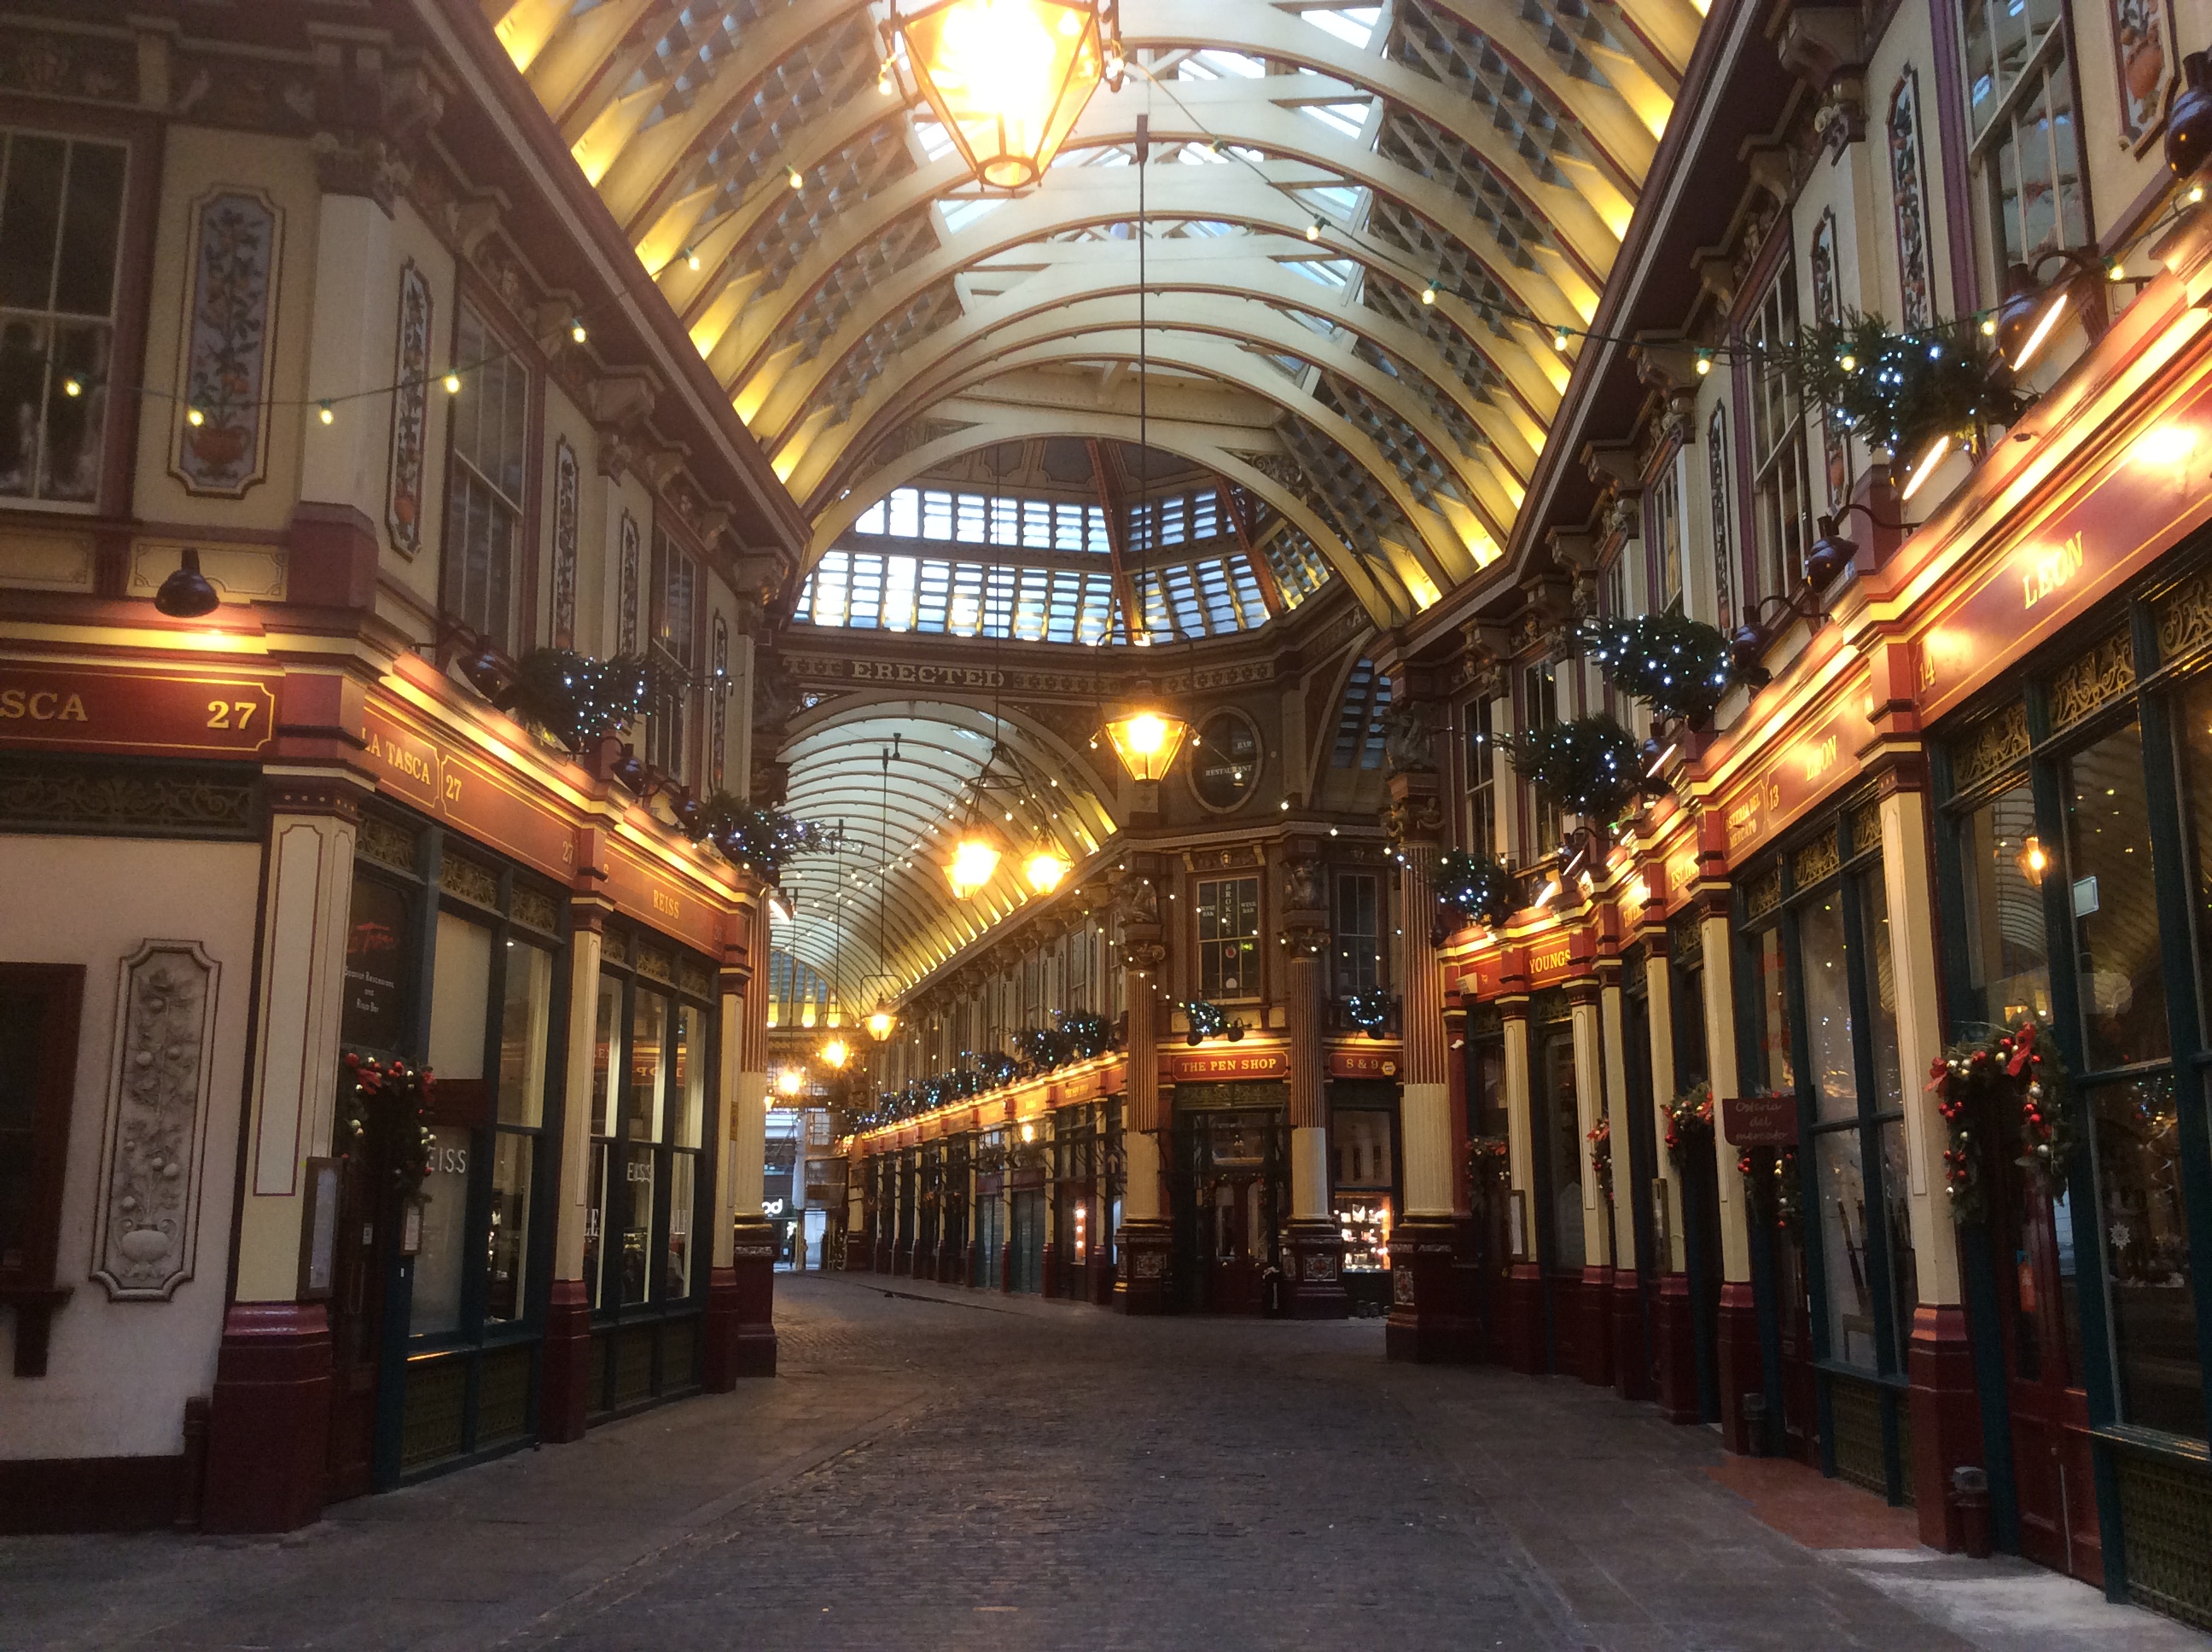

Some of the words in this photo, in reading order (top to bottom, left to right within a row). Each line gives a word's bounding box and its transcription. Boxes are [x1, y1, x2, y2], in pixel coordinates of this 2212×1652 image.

[2023, 531, 2083, 609] LEON
[852, 660, 1004, 687] ERECTED
[1919, 655, 1936, 692] 14
[0, 689, 88, 722] SCA
[207, 701, 257, 730] 27
[385, 741, 431, 785] TASCA
[1205, 765, 1253, 776] RESTAURANT
[1807, 734, 1837, 781] LEON
[445, 774, 463, 802] 27
[1769, 784, 1779, 811] 13
[653, 889, 679, 920] REISS
[1182, 1062, 1206, 1073] THE
[1210, 1061, 1236, 1071] PEN
[1241, 1058, 1277, 1070] SHOP
[1358, 1059, 1367, 1069] &
[1371, 1059, 1379, 1069] 9
